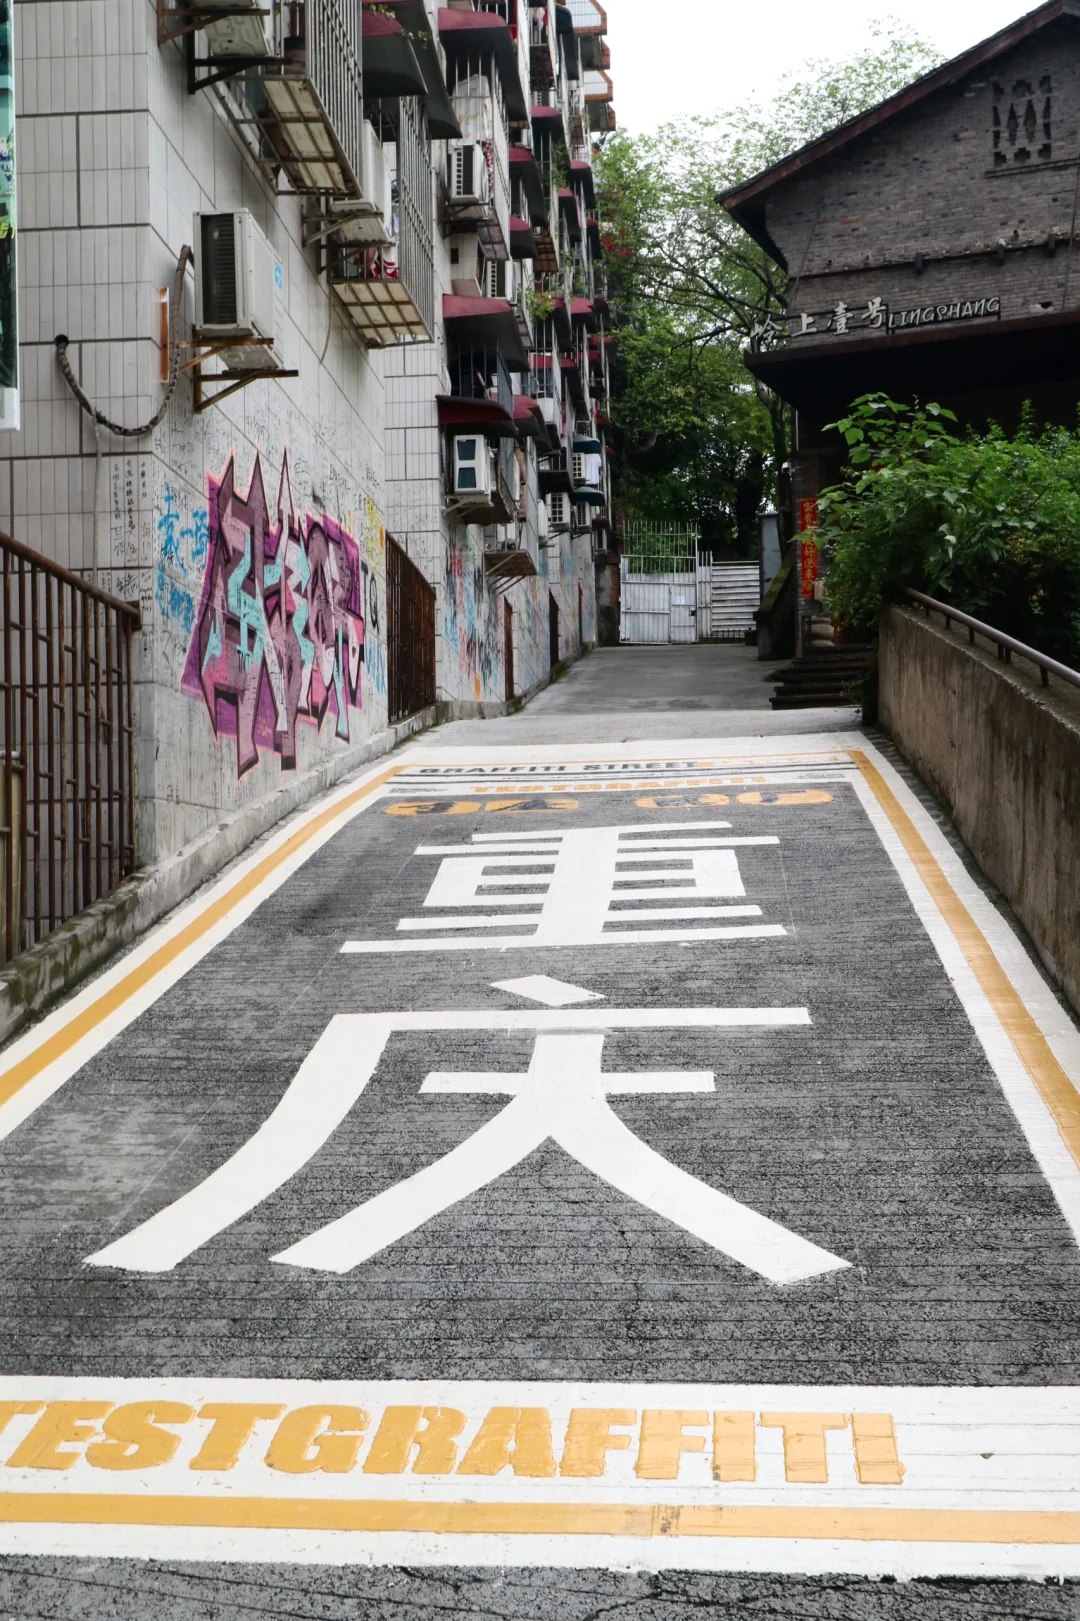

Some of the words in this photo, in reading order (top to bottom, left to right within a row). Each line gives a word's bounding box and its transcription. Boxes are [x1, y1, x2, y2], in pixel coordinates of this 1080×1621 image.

[419, 765, 567, 774] GRAFFITI
[583, 761, 699, 771] STREET
[82, 820, 853, 1287] 重庆
